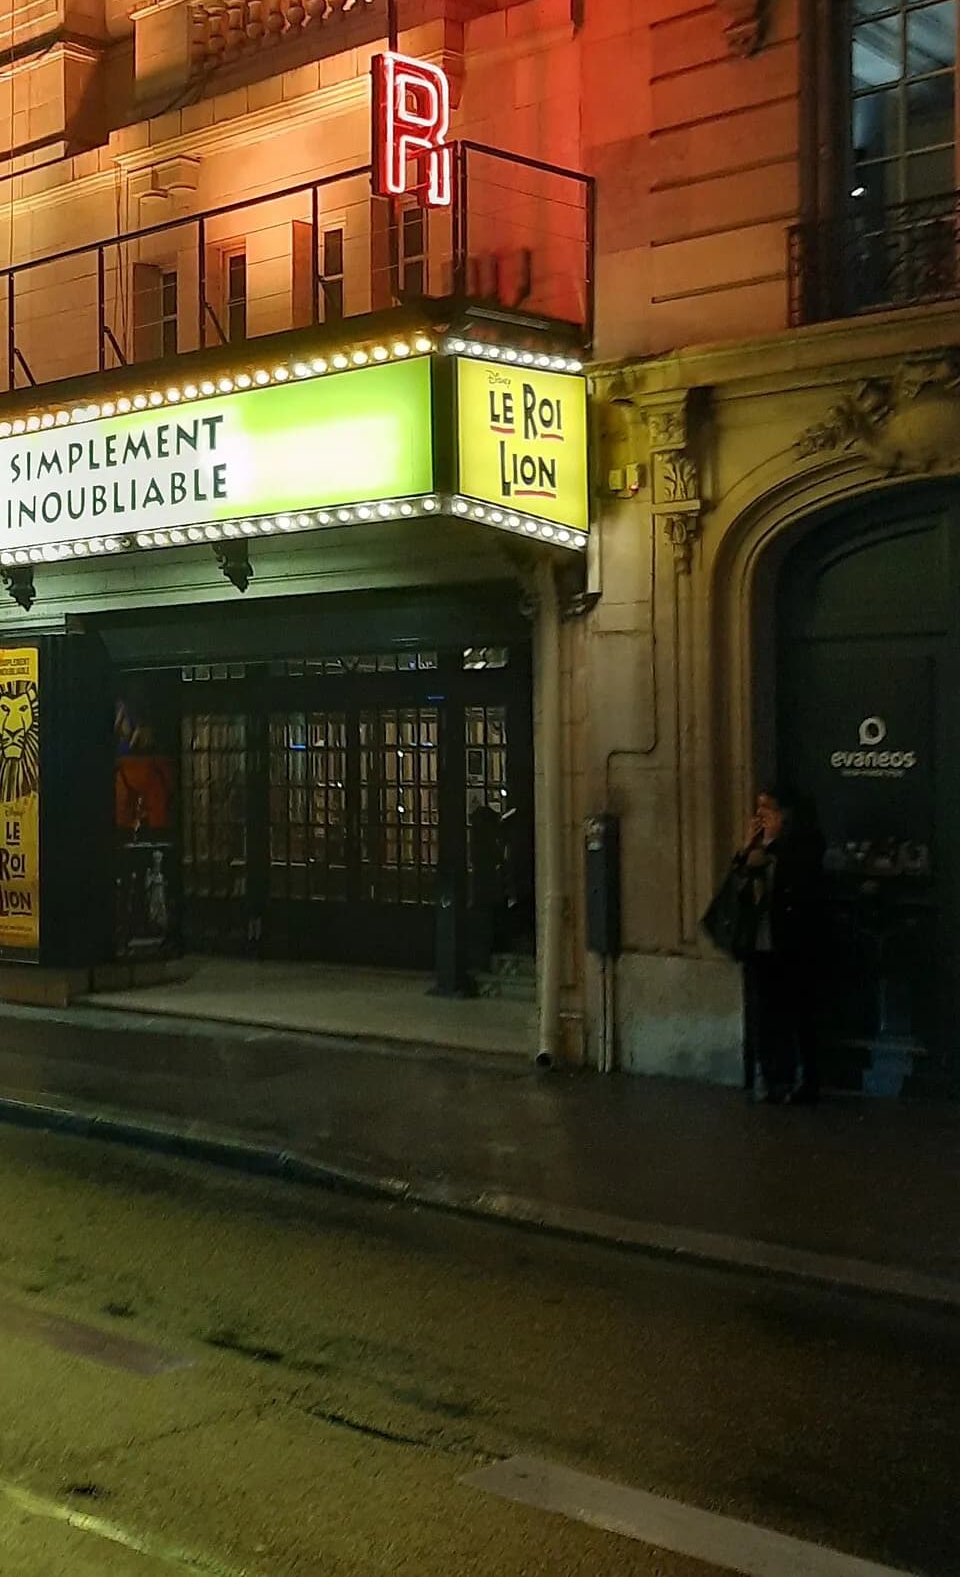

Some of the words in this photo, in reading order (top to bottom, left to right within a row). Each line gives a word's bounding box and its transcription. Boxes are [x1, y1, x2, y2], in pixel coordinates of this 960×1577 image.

[490, 391, 514, 424] LE
[522, 383, 564, 440] ROI
[10, 415, 223, 483] SIMPLEMENT
[500, 440, 556, 496] LION
[7, 463, 227, 528] INOUBLIABLE
[830, 750, 918, 769] evaneos
[6, 821, 21, 840] LE
[0, 847, 26, 881] ROI
